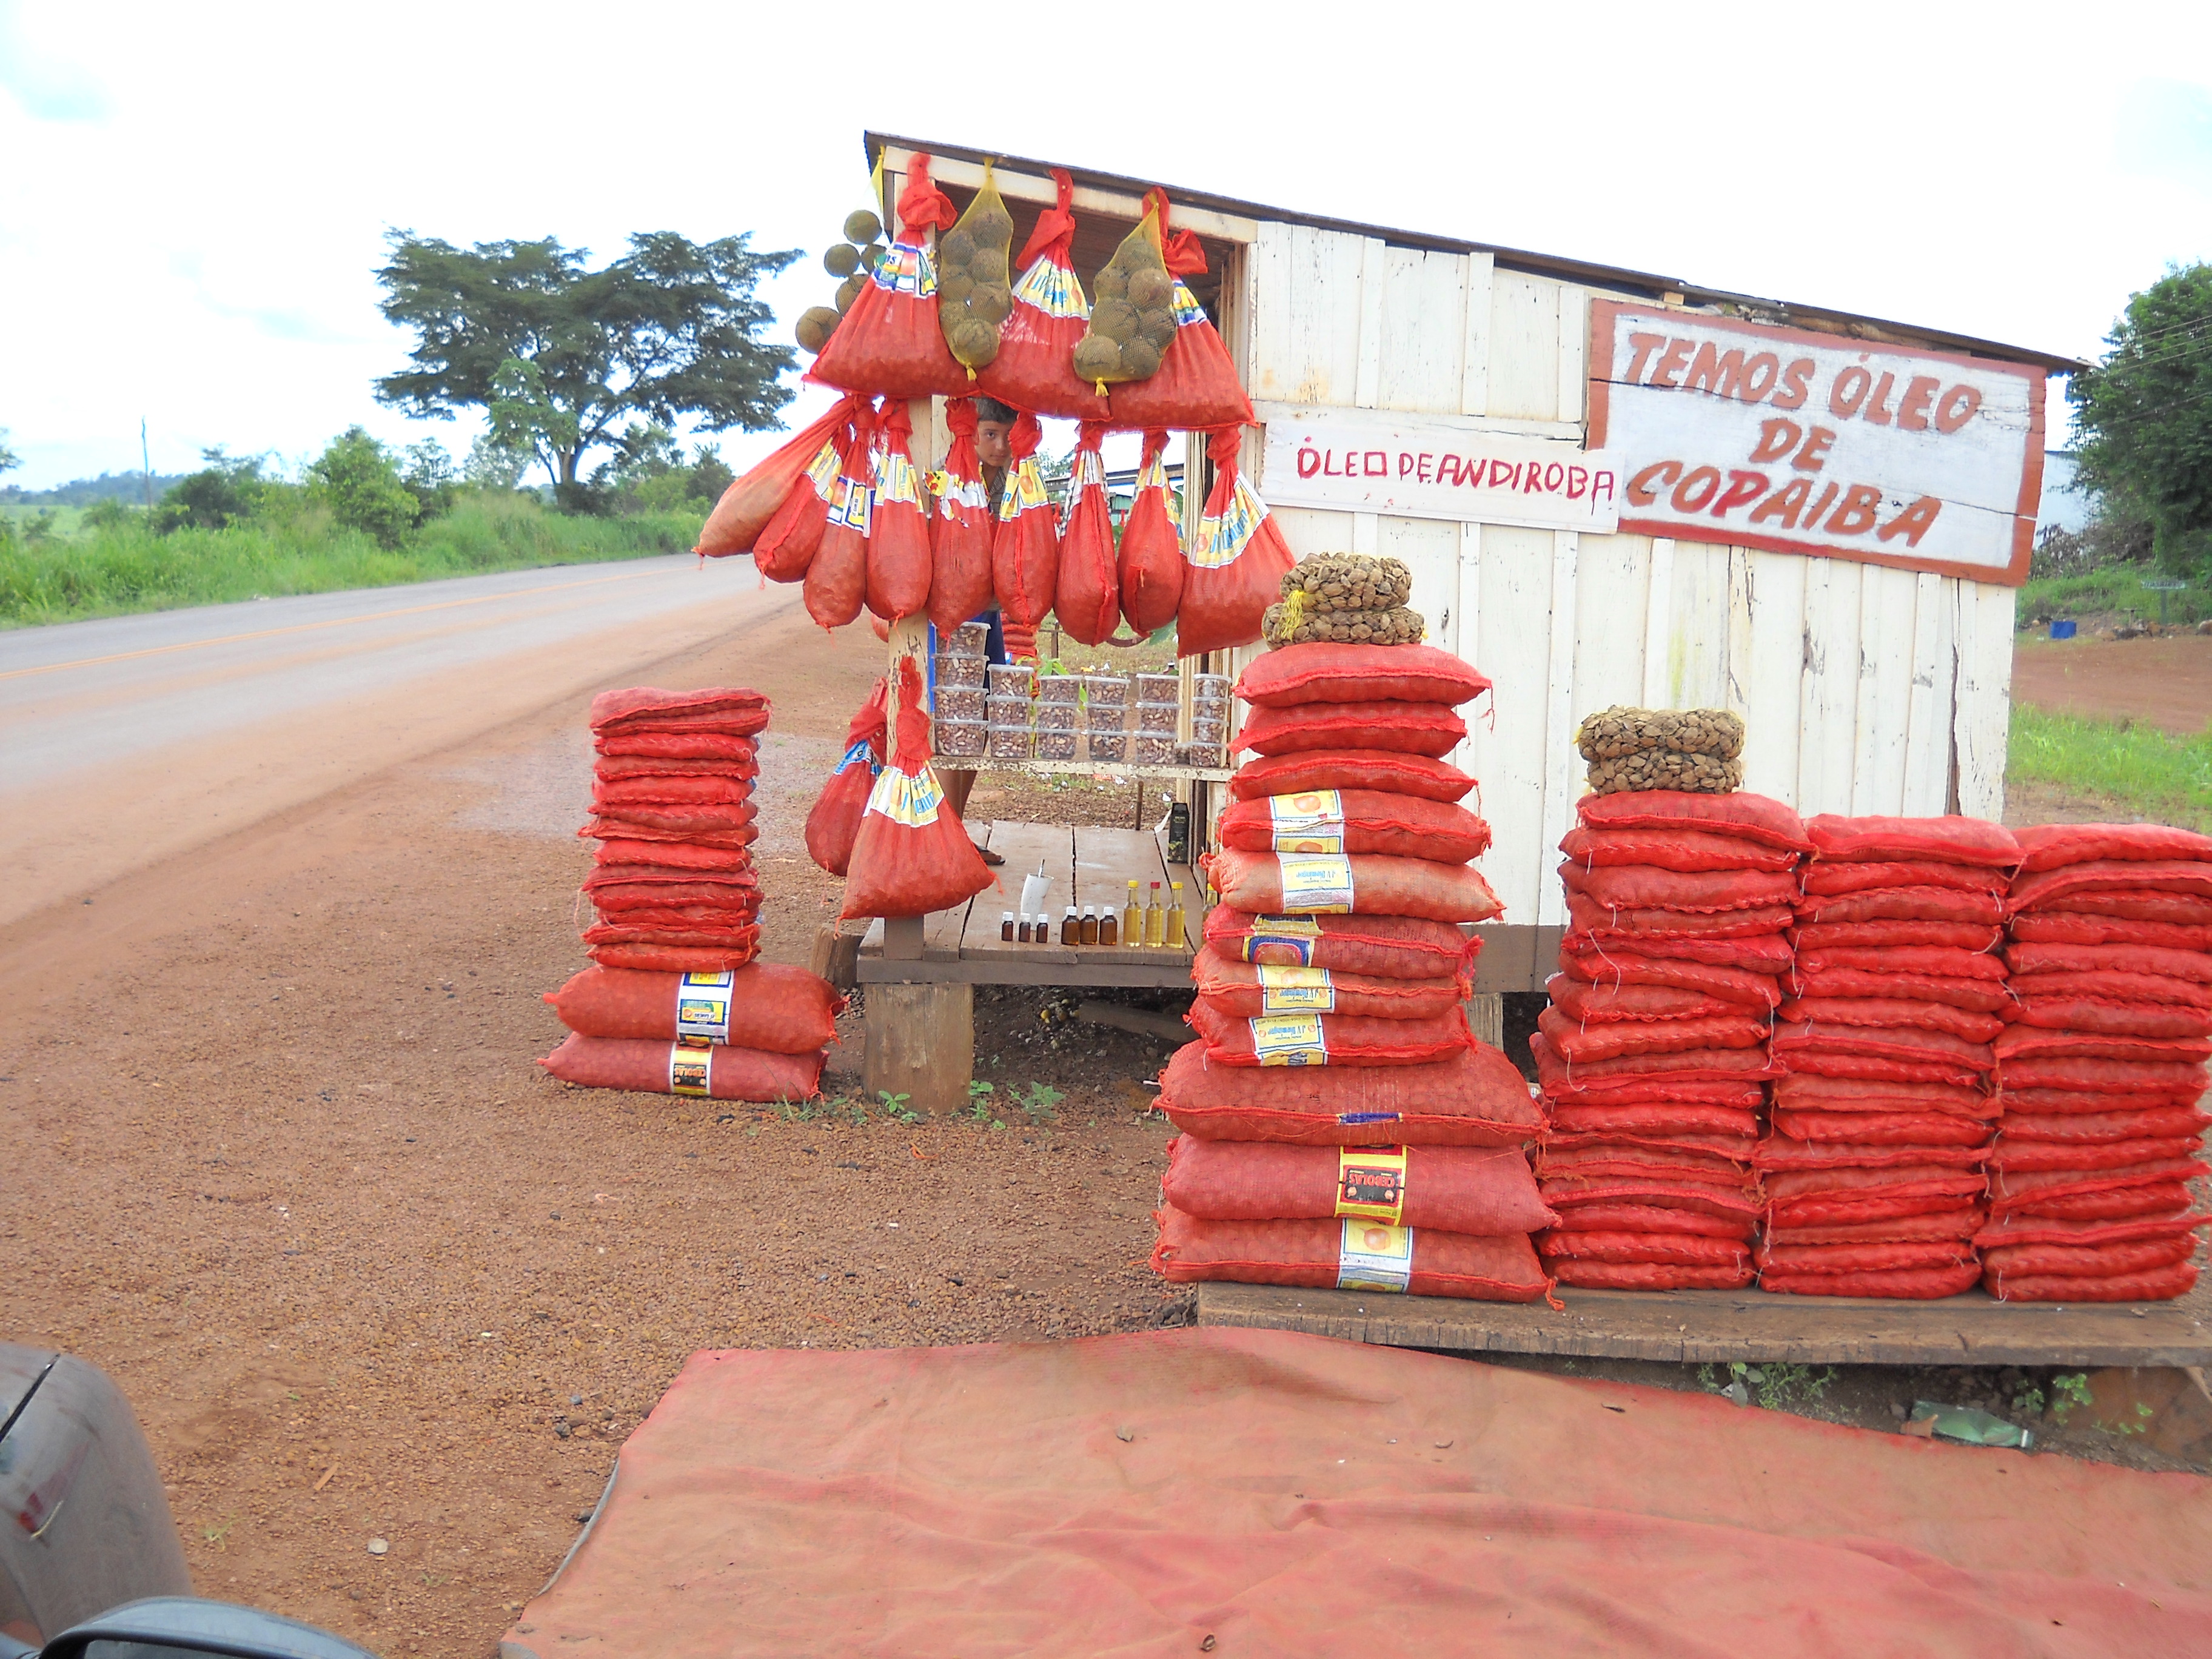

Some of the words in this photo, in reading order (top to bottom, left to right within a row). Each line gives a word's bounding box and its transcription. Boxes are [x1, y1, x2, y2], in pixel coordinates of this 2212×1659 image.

[1625, 332, 1815, 410] TEMOS
[1828, 353, 1982, 434] ÓLEO
[1297, 436, 1388, 479] ÓLEO
[1749, 418, 1836, 471] DE
[1627, 461, 1941, 548] COPAIBA
[1349, 1174, 1395, 1187] CEBOLAS
